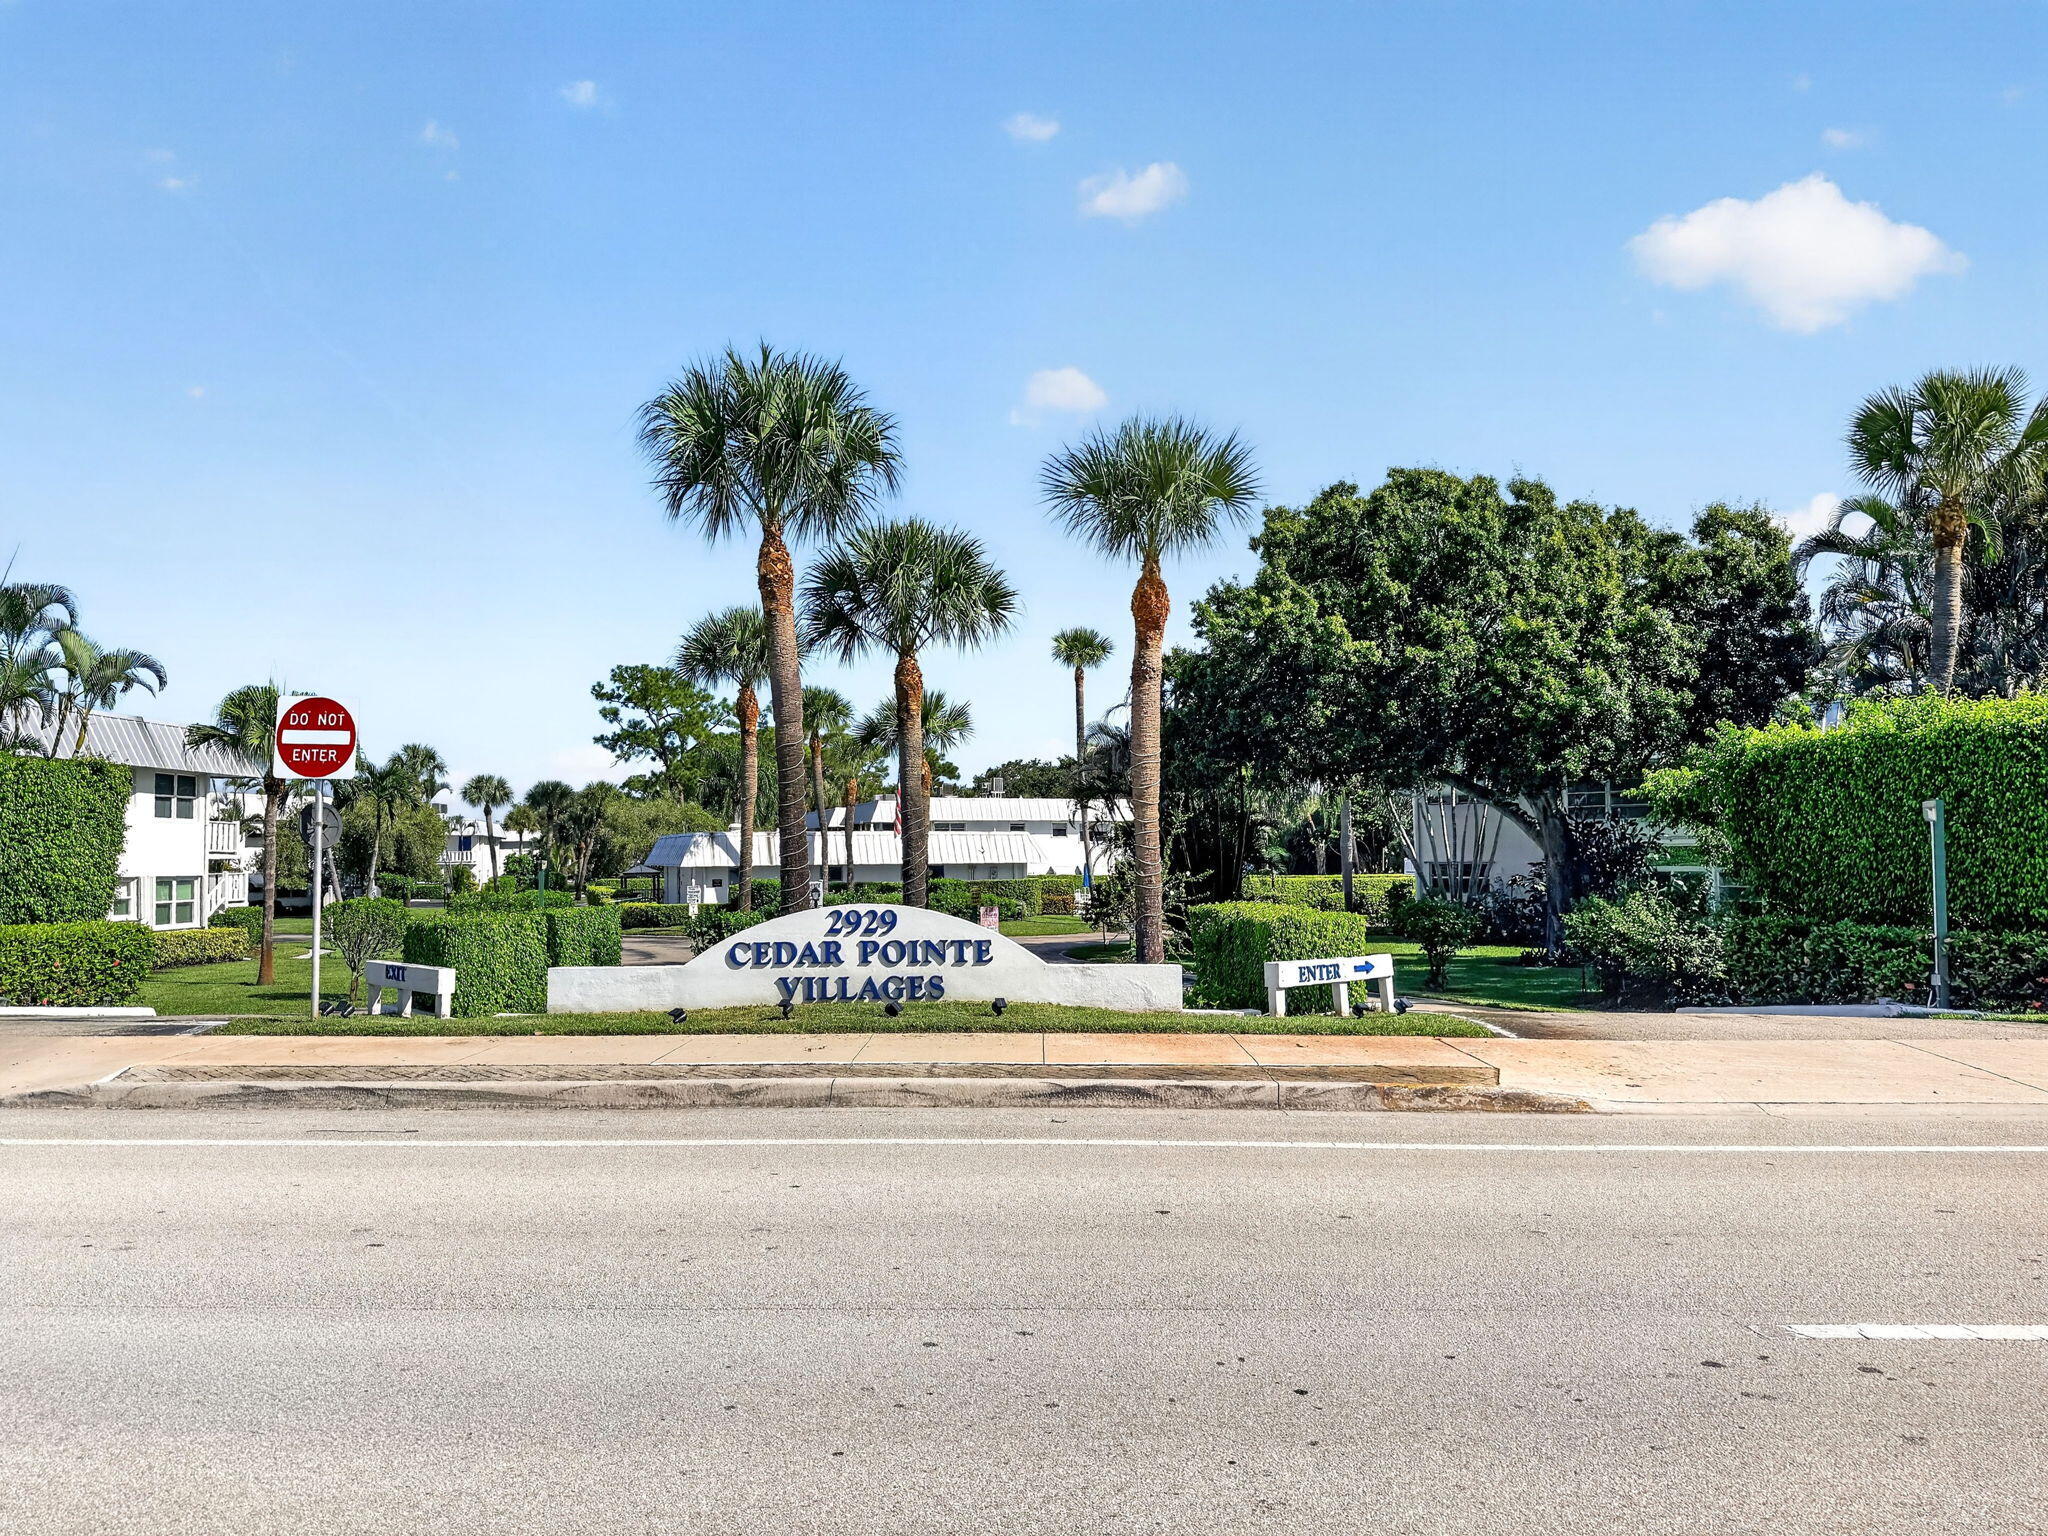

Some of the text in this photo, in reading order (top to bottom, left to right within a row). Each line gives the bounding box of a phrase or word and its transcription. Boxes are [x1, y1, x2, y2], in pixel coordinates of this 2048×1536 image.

[289, 713, 345, 726] DO NOT
[292, 749, 337, 762] ENTER
[825, 909, 897, 937] 2929
[725, 939, 994, 970] CEDAR POINTE
[385, 964, 408, 982] EXIT
[1298, 963, 1342, 983] ENTER
[775, 975, 945, 1004] VILLAGES
